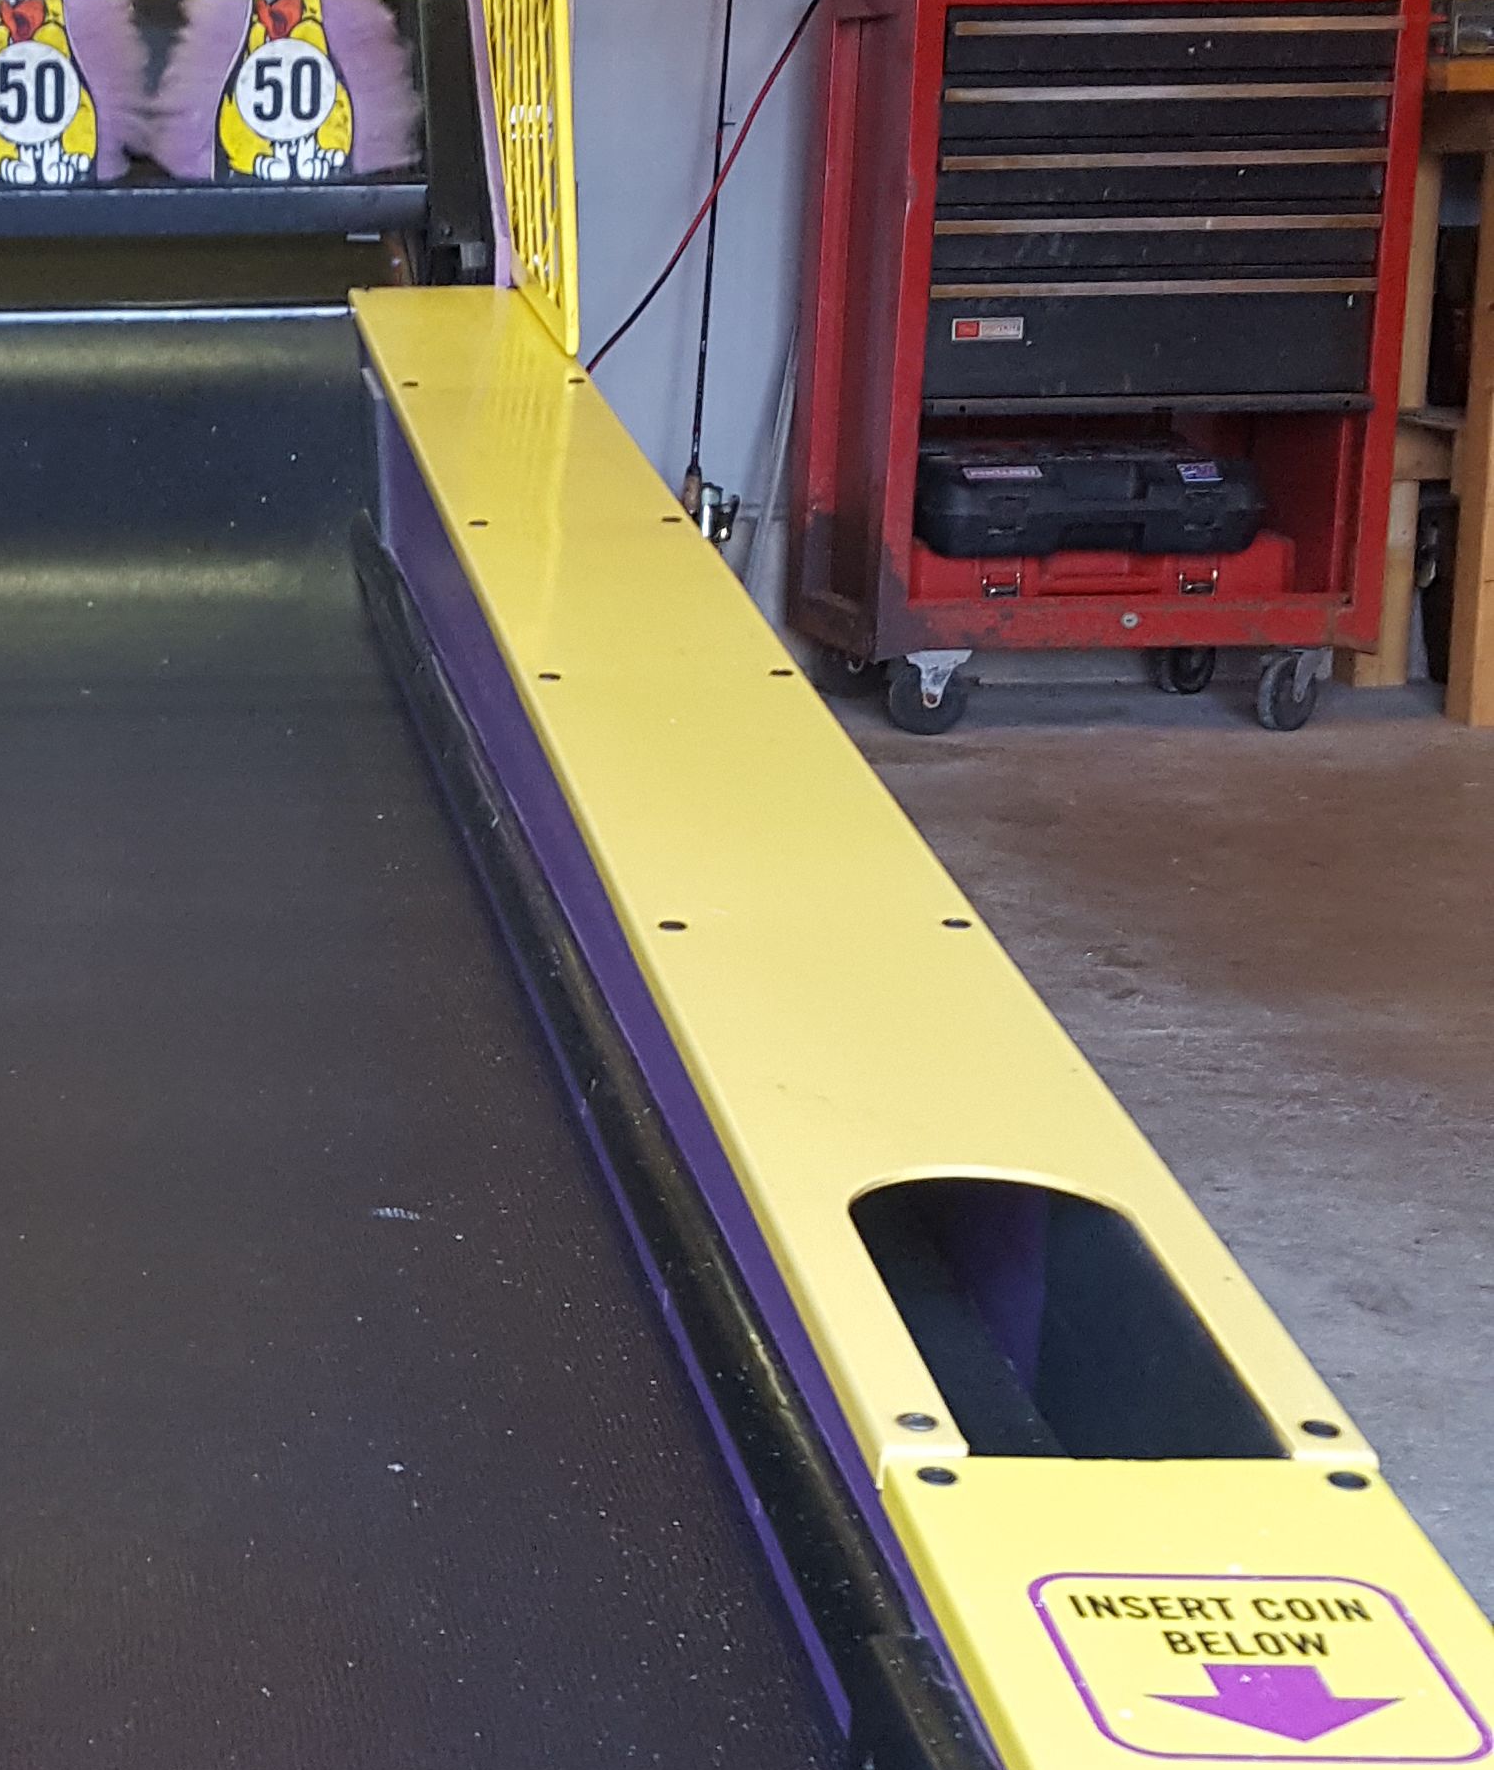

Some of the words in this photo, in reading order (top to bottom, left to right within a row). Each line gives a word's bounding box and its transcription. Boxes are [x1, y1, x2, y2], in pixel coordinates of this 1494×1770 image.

[253, 57, 322, 122] 50
[1068, 1595, 1236, 1621] INSERT
[1252, 1597, 1373, 1622] COIN
[1163, 1630, 1329, 1656] BELOW
